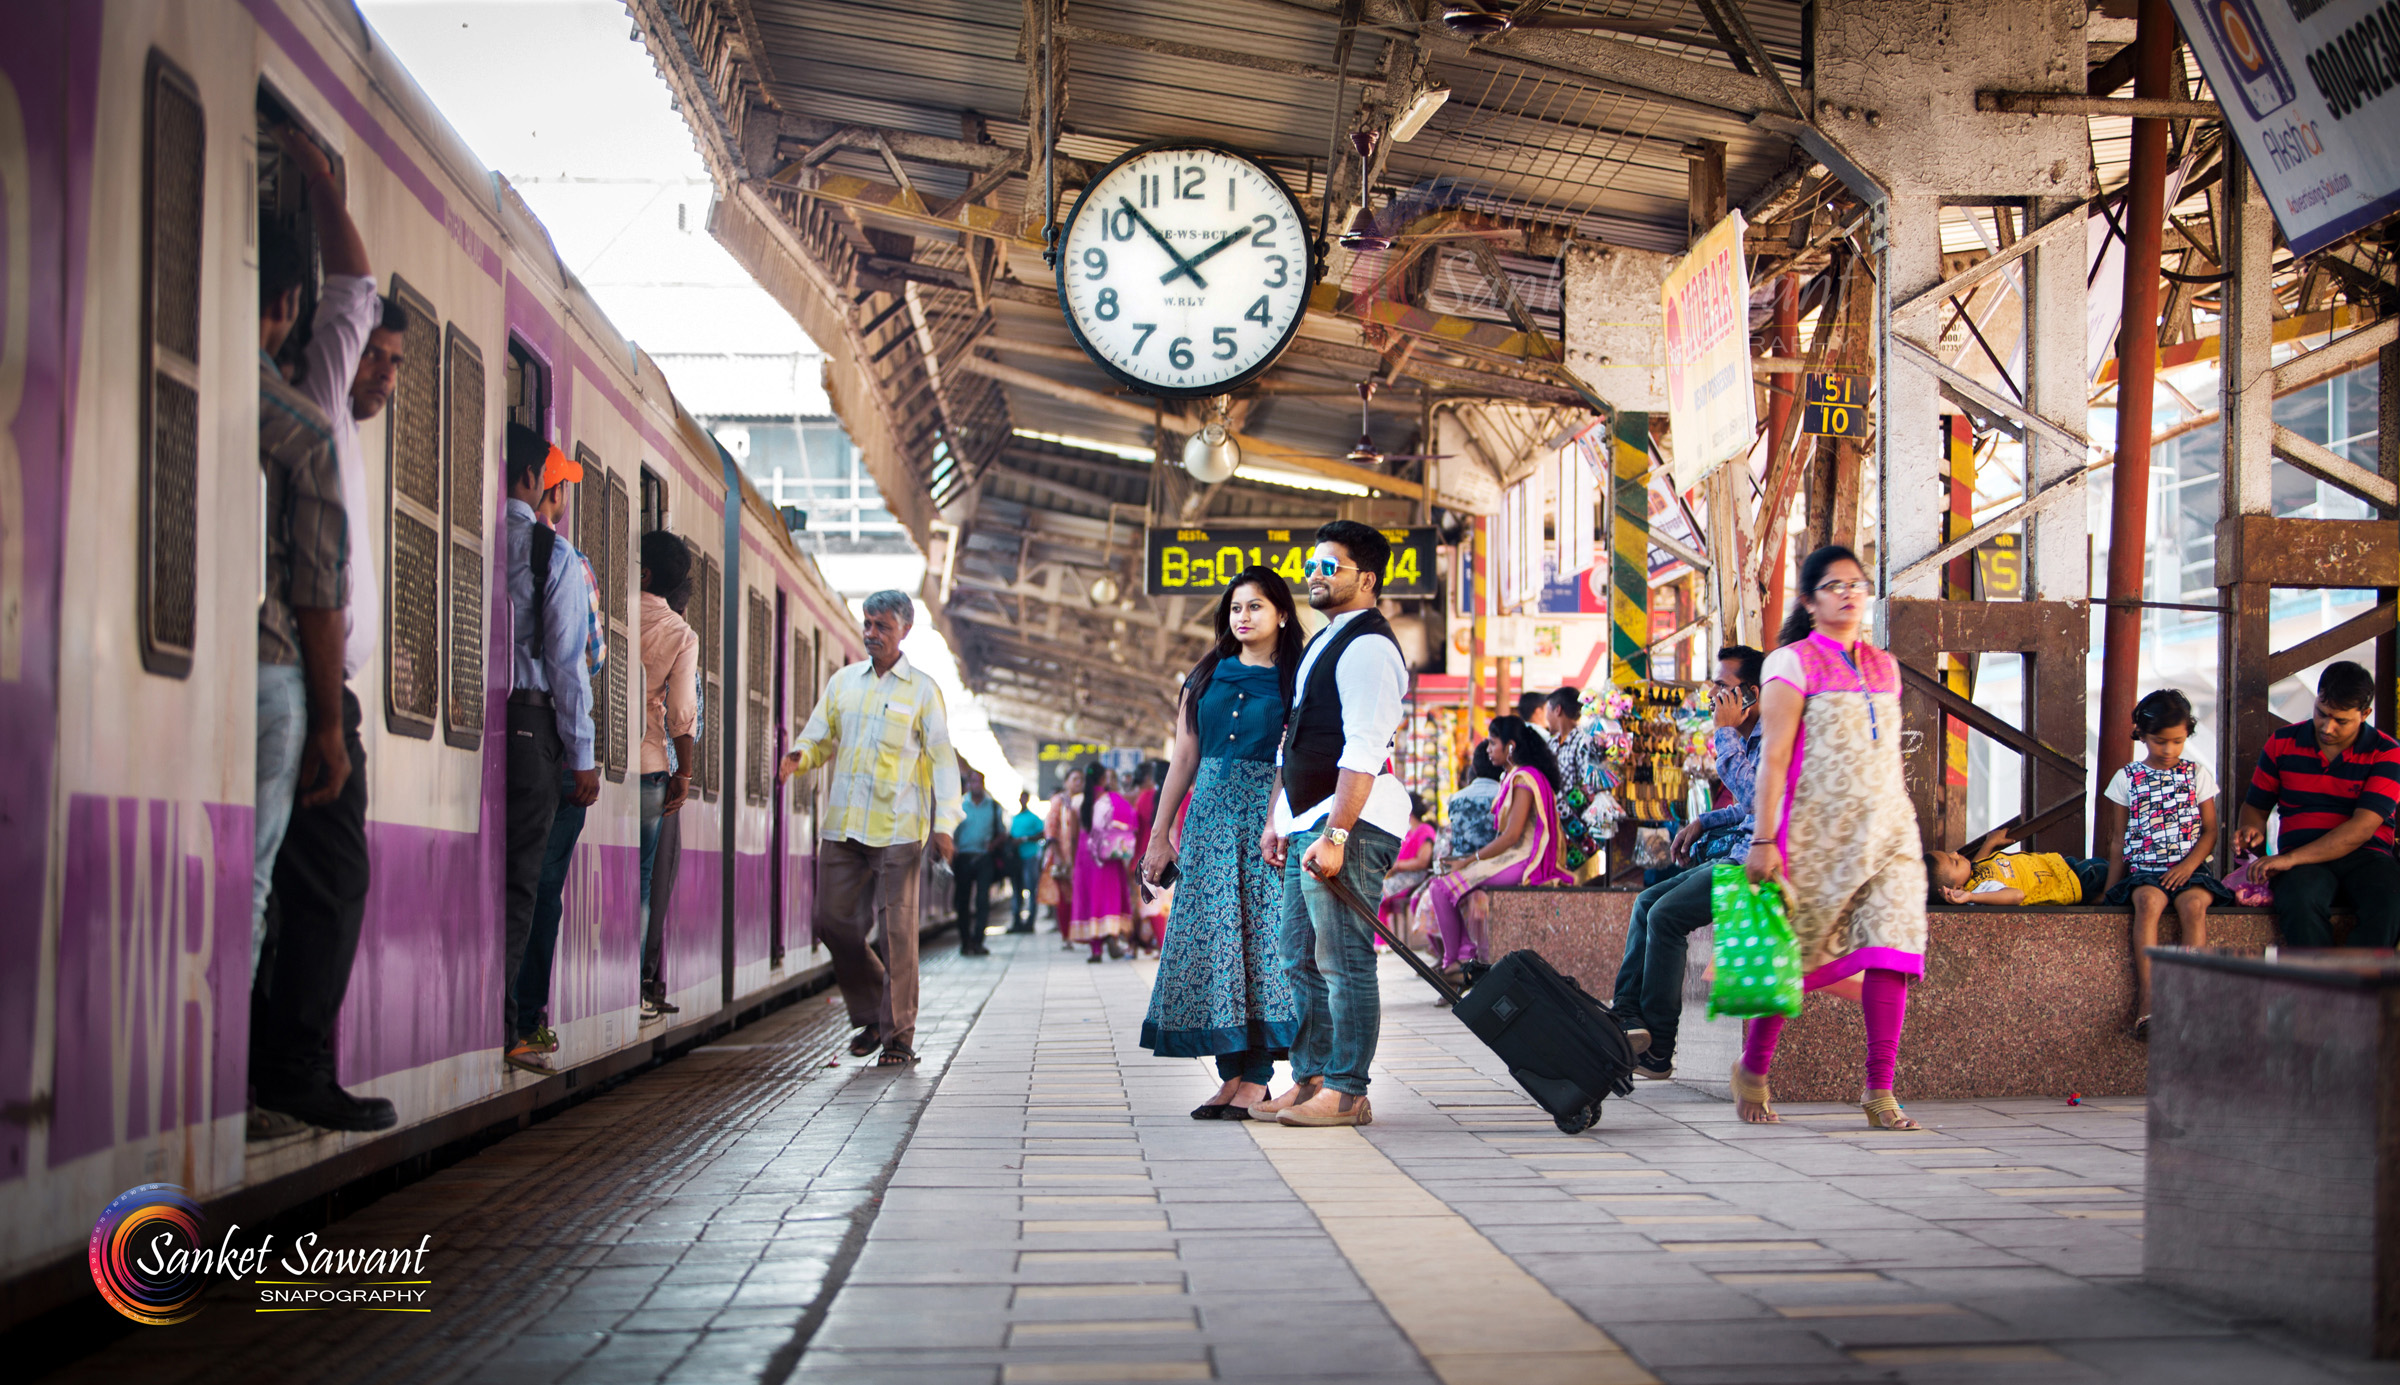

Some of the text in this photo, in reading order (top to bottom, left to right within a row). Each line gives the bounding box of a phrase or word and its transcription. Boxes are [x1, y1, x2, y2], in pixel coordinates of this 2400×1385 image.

[1140, 175, 1160, 209] 11
[1173, 166, 1206, 200] 12
[1228, 178, 1236, 212] 1
[2285, 173, 2352, 216] Advertising Solution
[1101, 208, 1137, 242] 10
[1250, 214, 1277, 248] 2
[1083, 247, 1108, 281] 9
[1263, 254, 1288, 288] 3
[1095, 287, 1120, 322] 8
[1244, 295, 1273, 328] 4
[1131, 323, 1157, 356] 7
[1168, 337, 1195, 371] 6
[1211, 327, 1238, 361] 5
[1825, 376, 1851, 403] 51
[1822, 407, 1849, 434] 10
[1267, 530, 1291, 542] TIME
[108, 796, 216, 1147] WR
